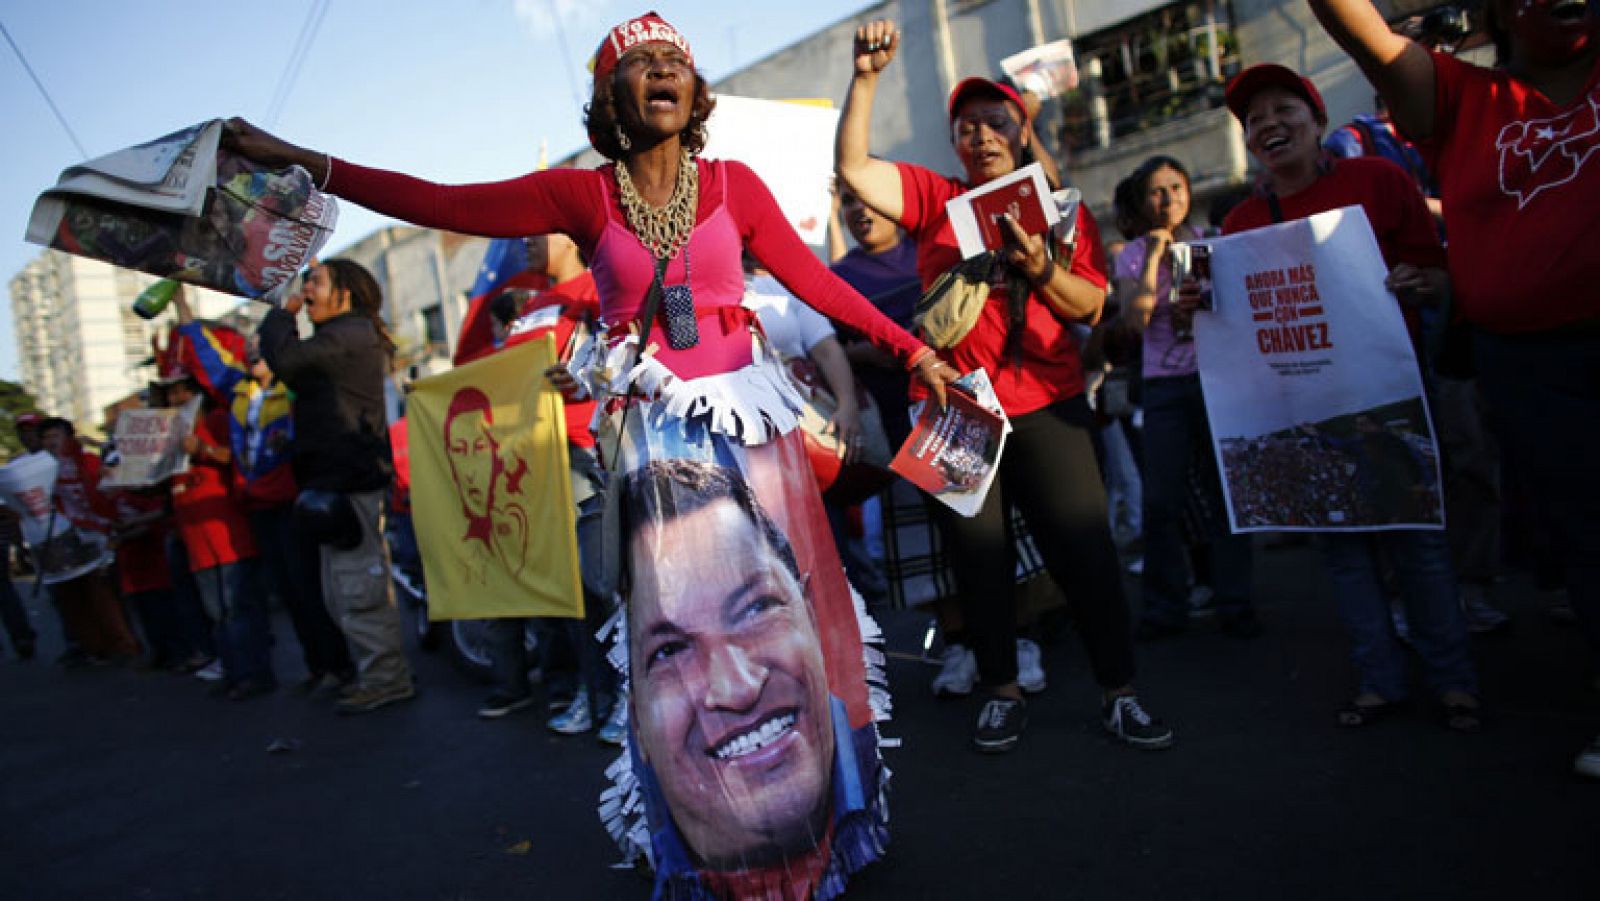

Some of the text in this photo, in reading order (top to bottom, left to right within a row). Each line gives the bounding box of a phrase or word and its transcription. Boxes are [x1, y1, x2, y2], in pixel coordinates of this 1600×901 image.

[1245, 264, 1315, 289] AHORA MÁS
[1249, 285, 1319, 308] QUE NUNCA
[1275, 305, 1298, 323] CON
[1257, 322, 1333, 353] CHÁVEZ
